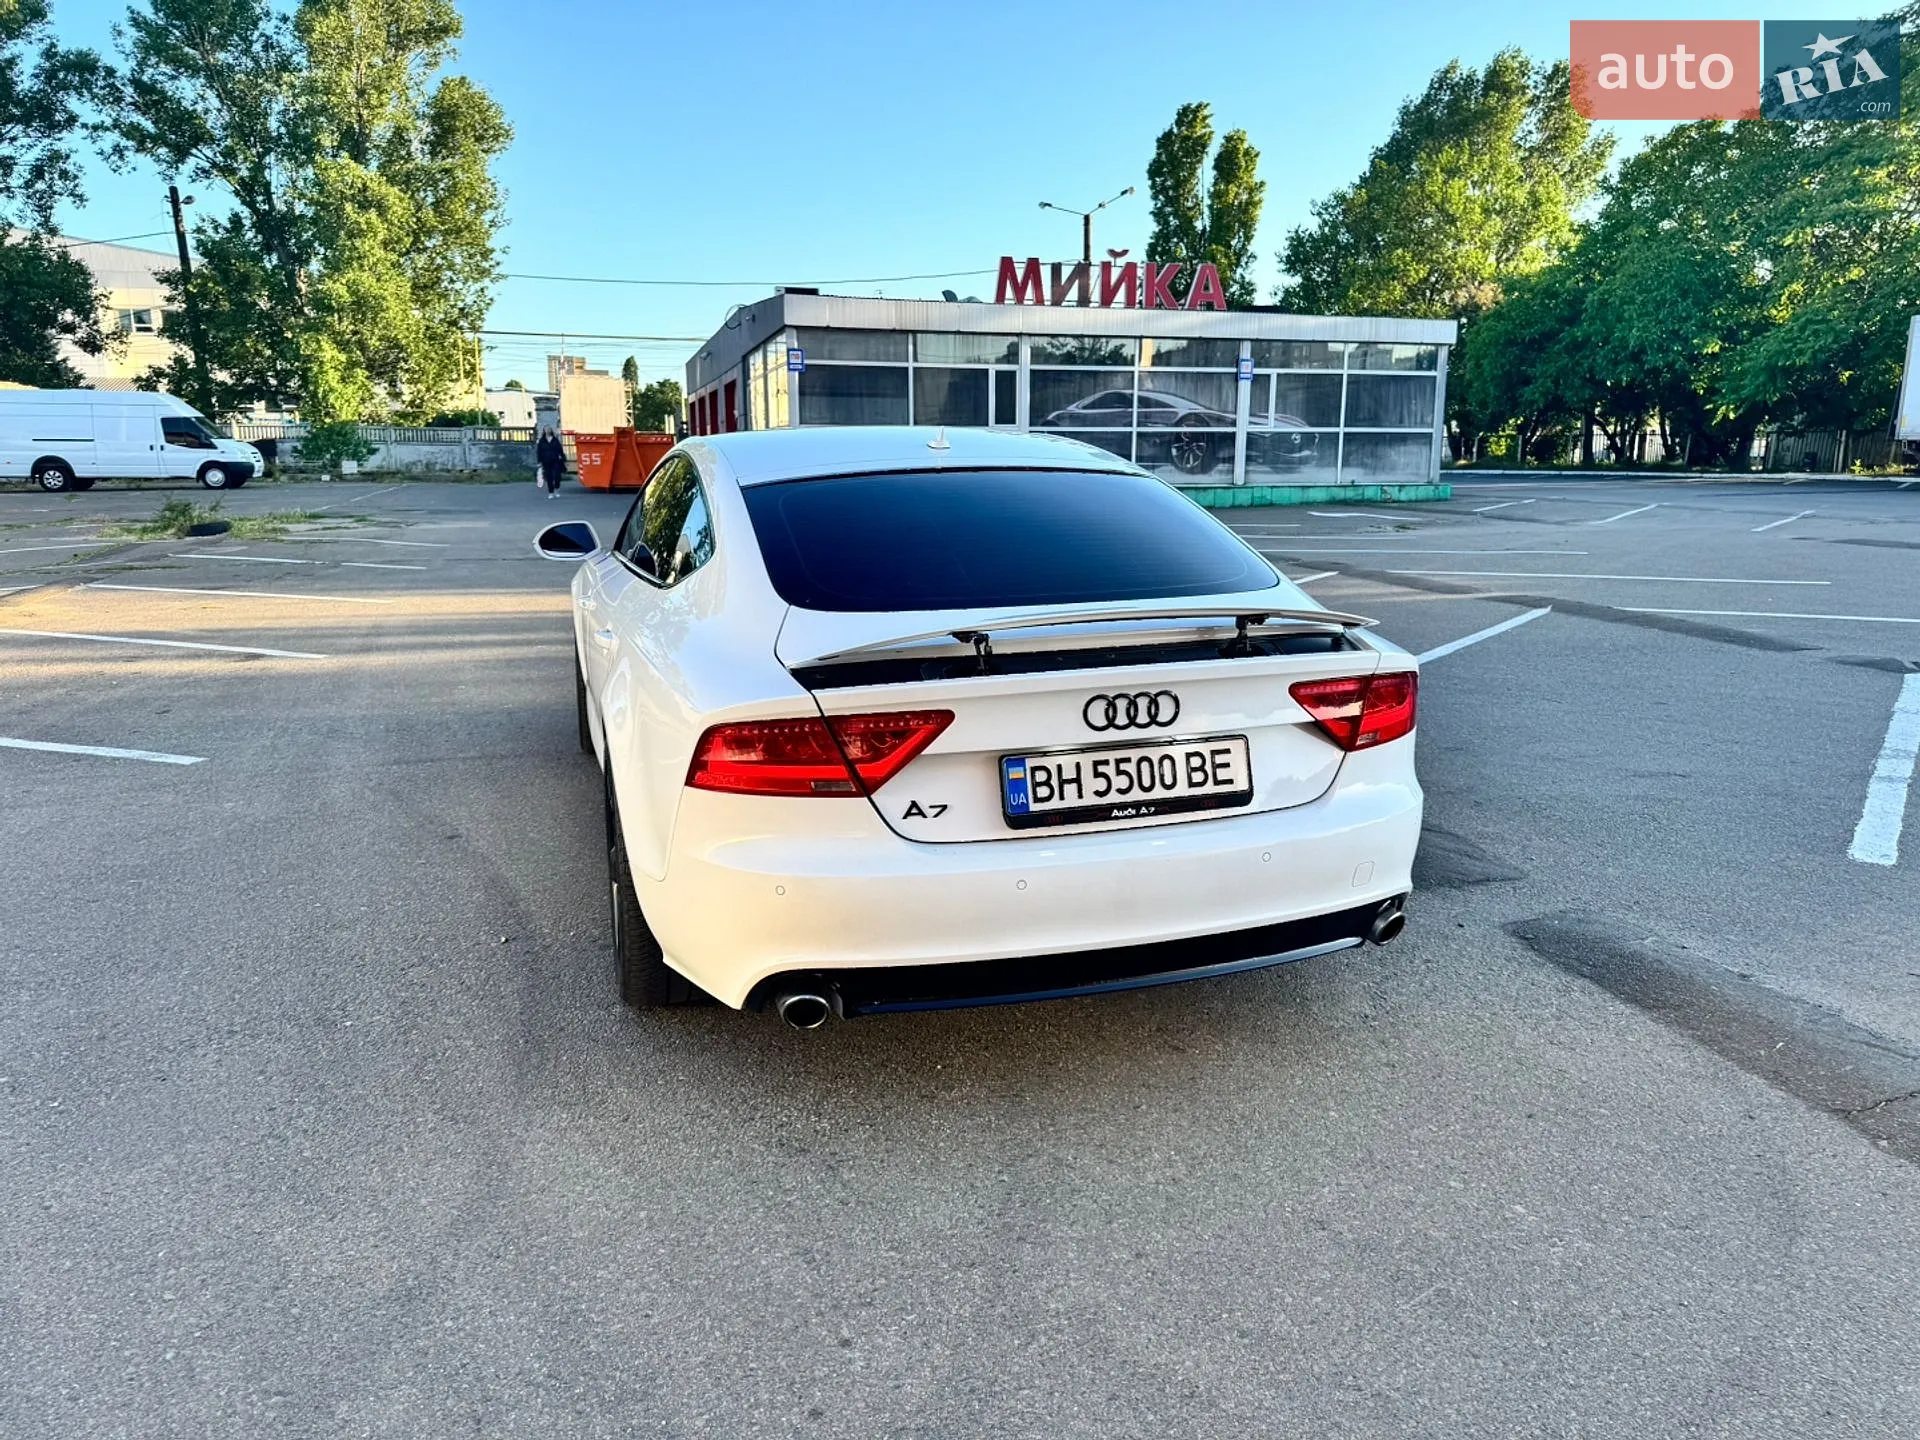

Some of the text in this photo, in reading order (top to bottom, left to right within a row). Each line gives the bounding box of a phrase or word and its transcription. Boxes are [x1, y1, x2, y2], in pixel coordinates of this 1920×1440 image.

[995, 249, 1227, 311] МИЙКА
[1029, 747, 1235, 804] BH 5500 BE
[902, 799, 948, 819] A7
[1010, 793, 1027, 806] UA
